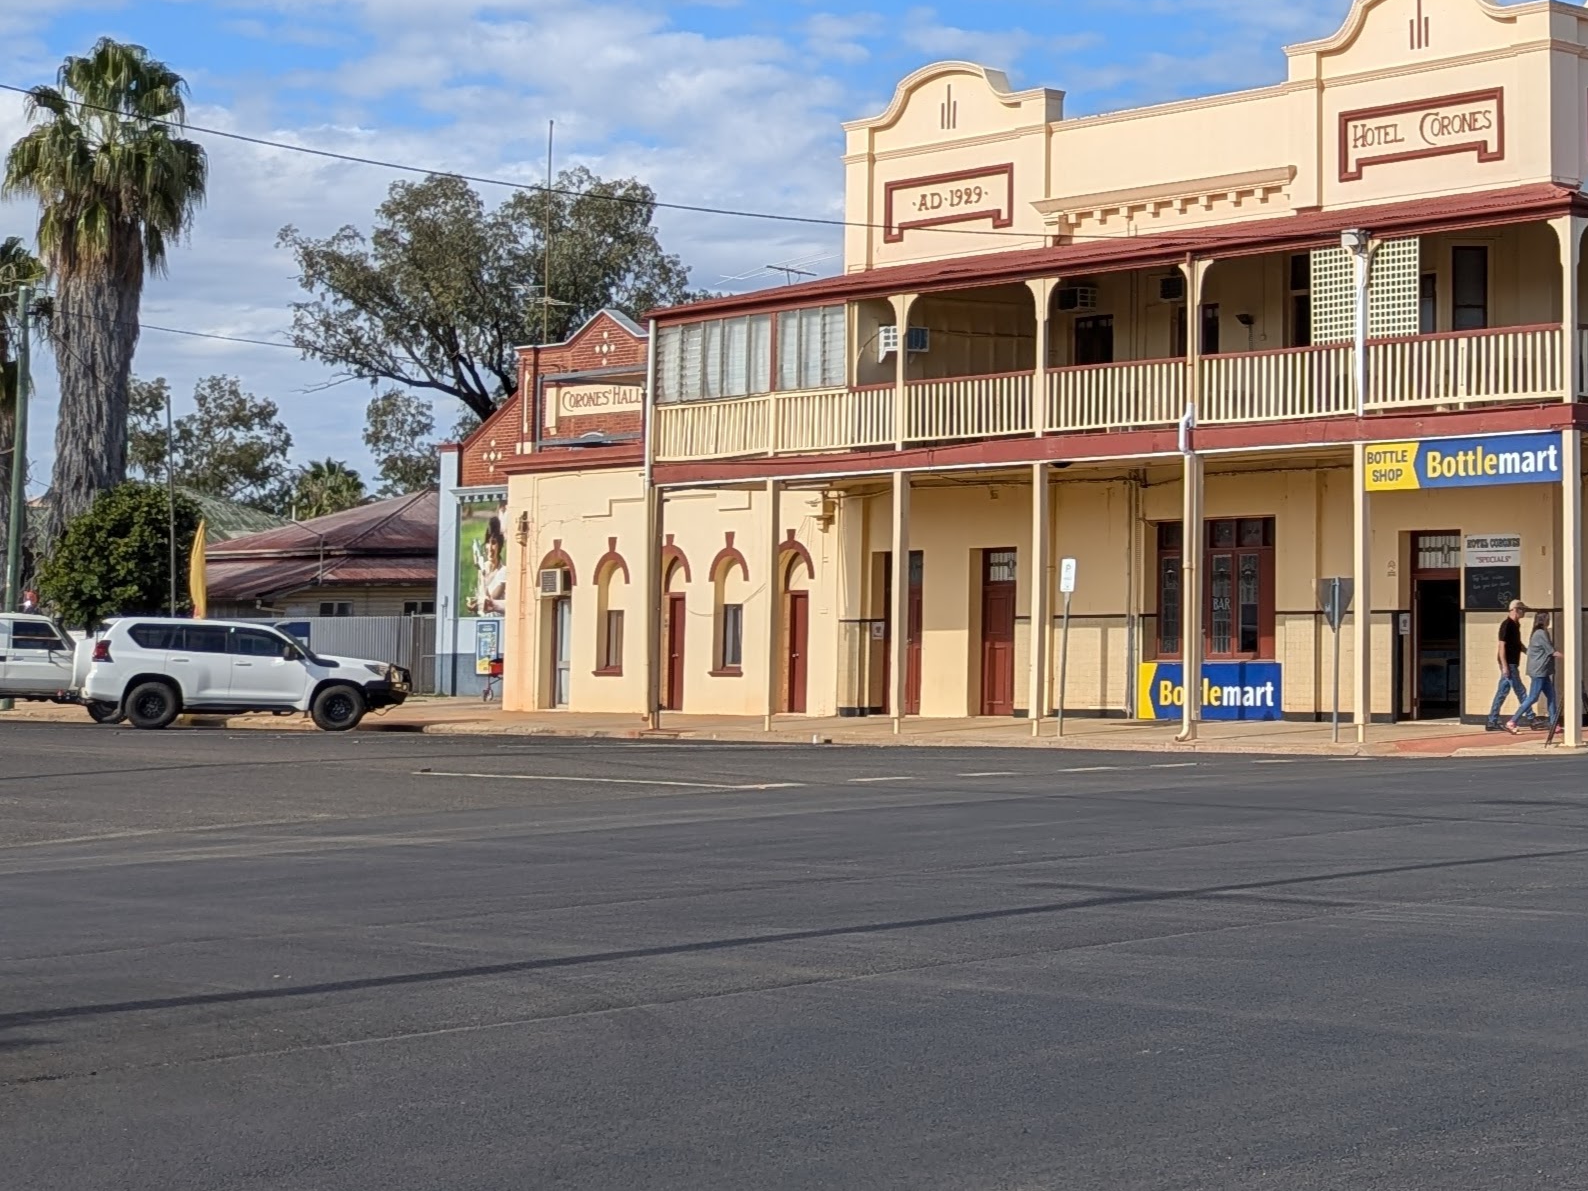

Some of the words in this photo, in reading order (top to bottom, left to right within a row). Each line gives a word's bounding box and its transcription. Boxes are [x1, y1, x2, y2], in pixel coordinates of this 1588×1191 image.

[1352, 124, 1405, 148] HOTEL
[1419, 110, 1492, 146] CORONES
[612, 386, 642, 406] HALL
[1366, 450, 1408, 465] BOTTLE
[1426, 444, 1558, 479] Bottlemart
[1372, 468, 1403, 483] SHOP
[1212, 597, 1231, 610] BAR
[1159, 677, 1275, 707] Bolemart
